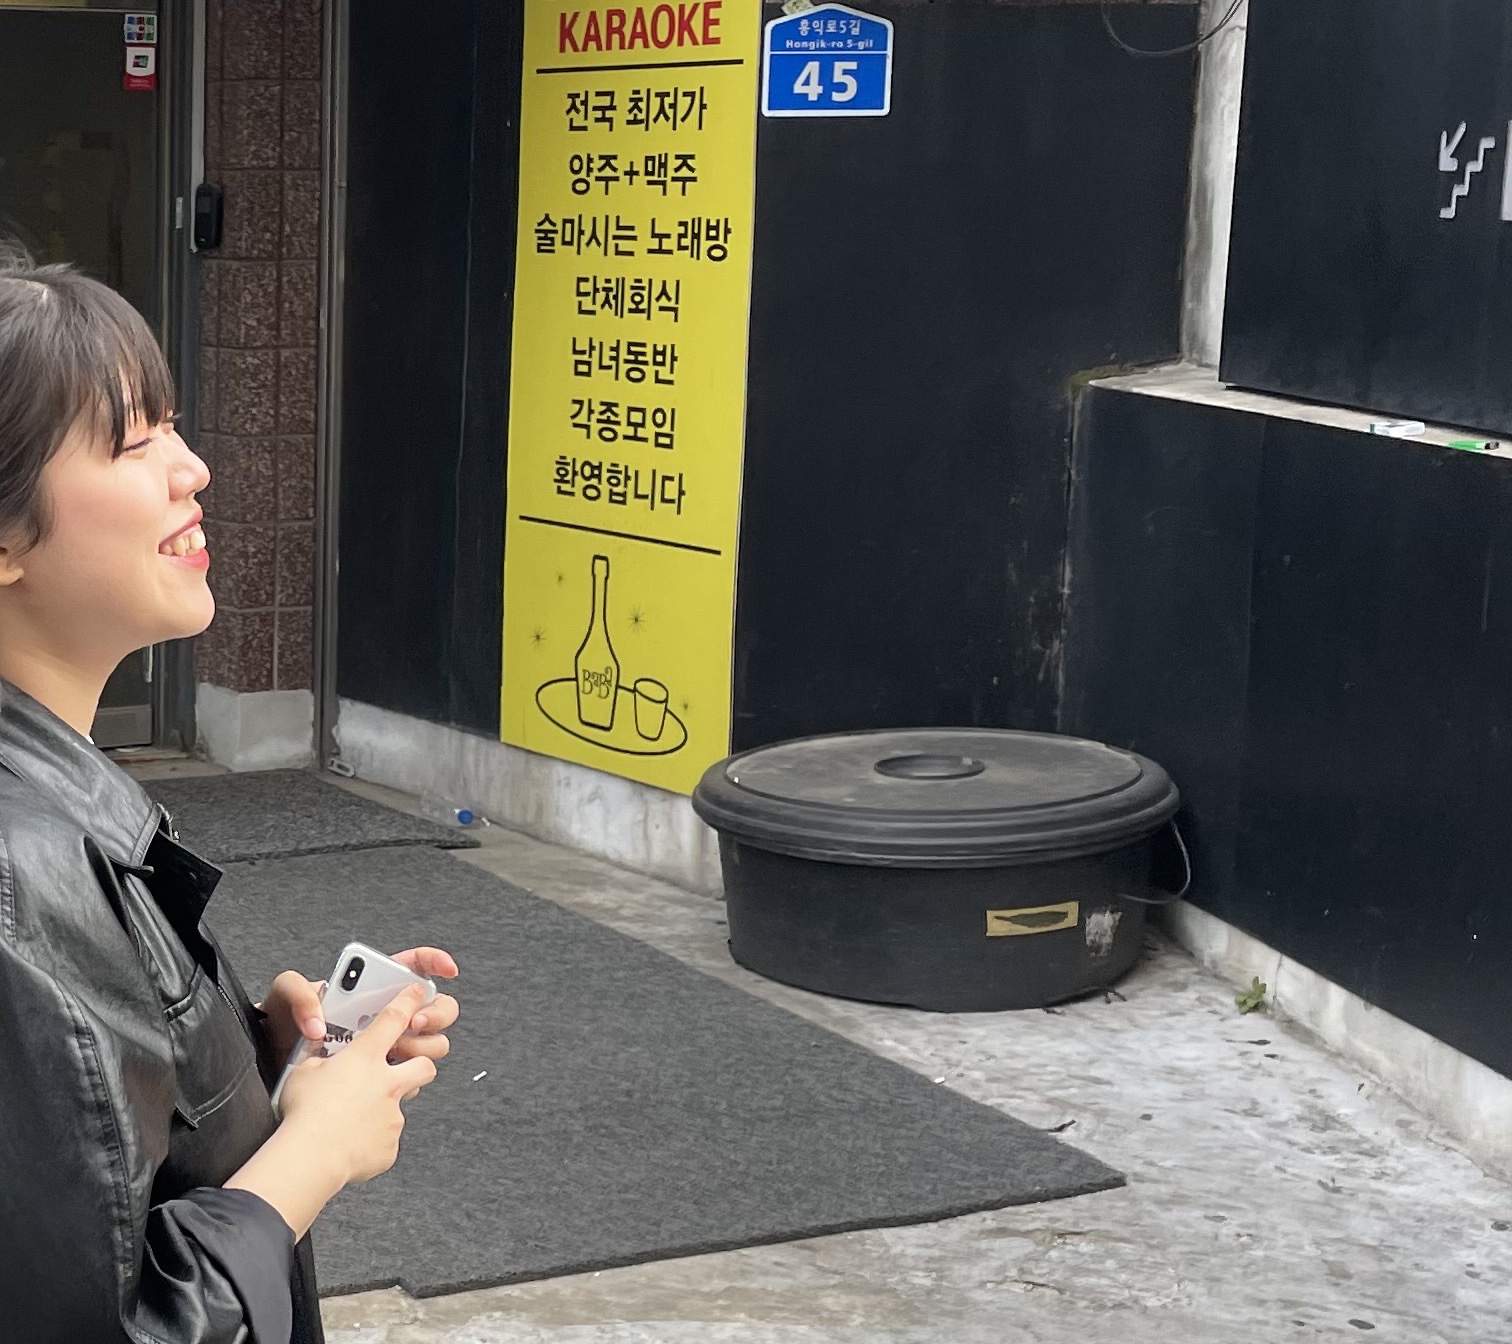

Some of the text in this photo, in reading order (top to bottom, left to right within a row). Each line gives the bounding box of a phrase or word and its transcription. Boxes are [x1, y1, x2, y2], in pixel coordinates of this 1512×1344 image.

[558, 1, 723, 54] KARAOKE
[786, 39, 874, 50] Hongik-ro 5-gil
[798, 18, 862, 36] 홍익로5길
[793, 61, 859, 103] 45
[565, 85, 708, 133] 전국 최저가
[569, 152, 699, 197] 양주+맥주
[534, 212, 733, 263] 술마시는 노래방
[574, 275, 681, 323] 단체회식
[571, 336, 679, 386] 남녀동반
[569, 397, 677, 450] 각종모임
[553, 455, 687, 516] 환영합니다
